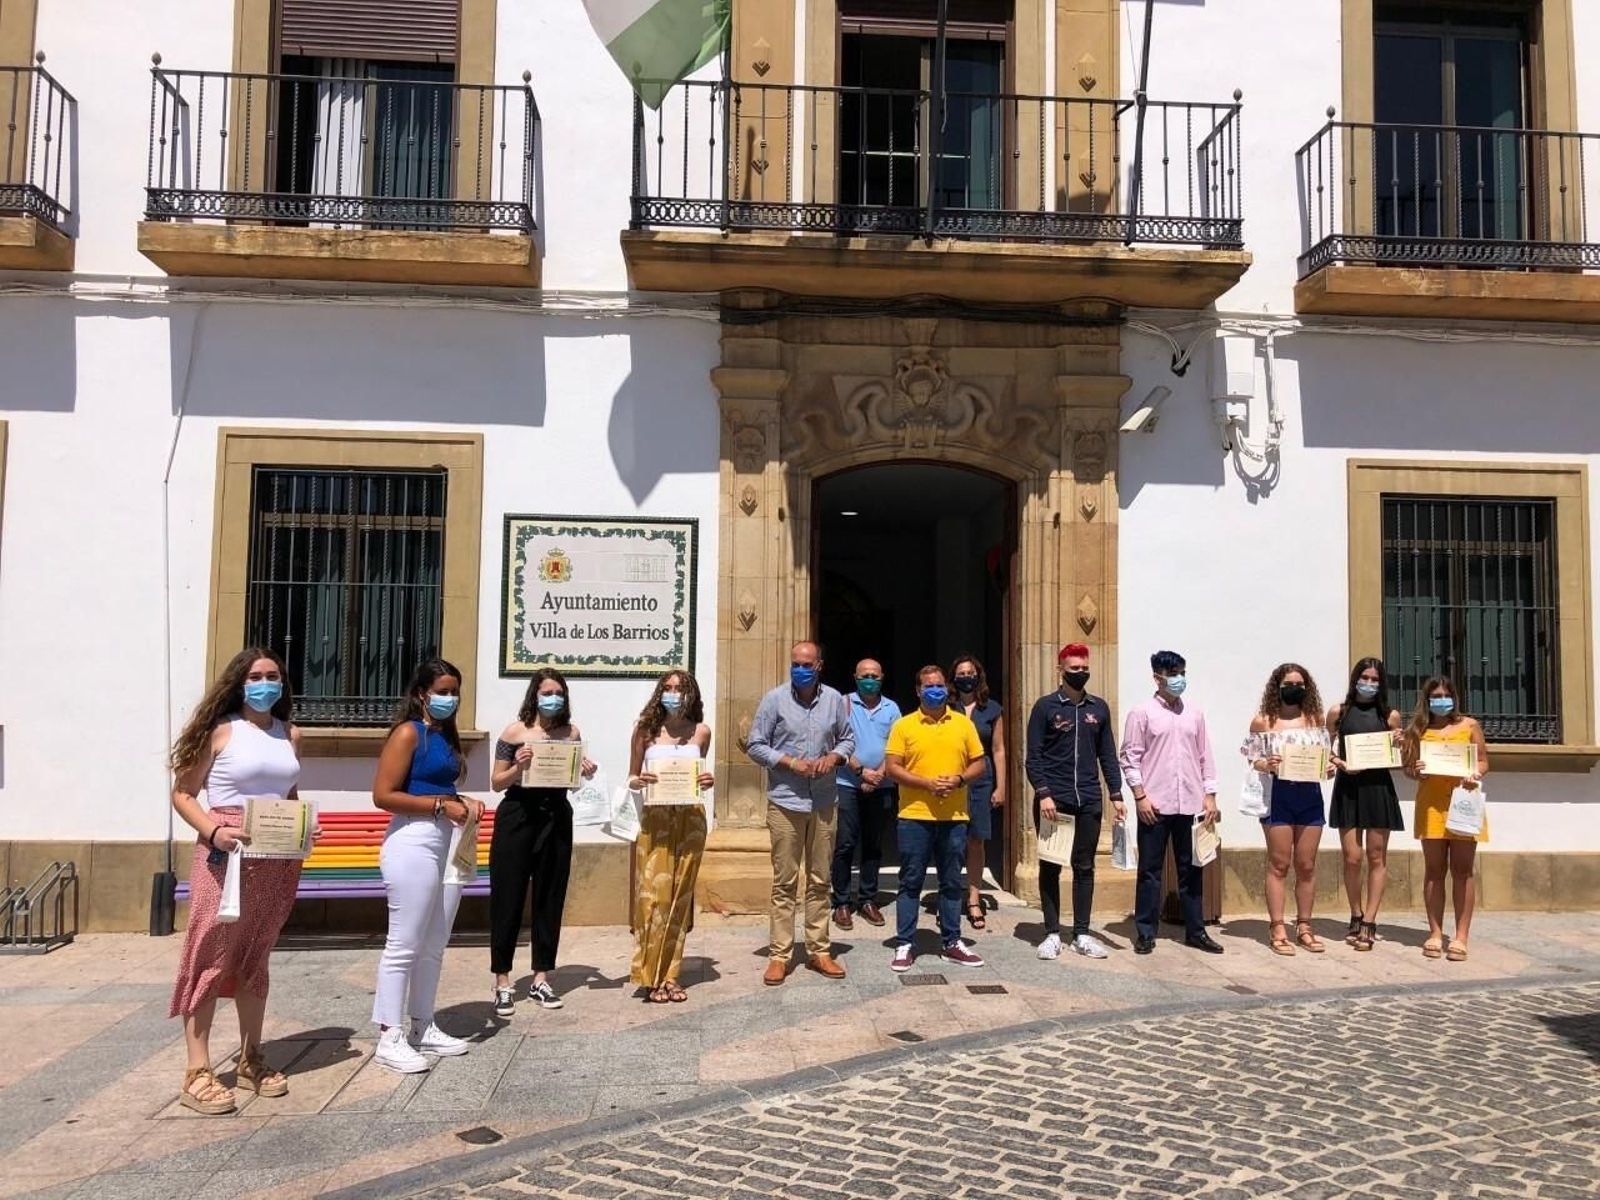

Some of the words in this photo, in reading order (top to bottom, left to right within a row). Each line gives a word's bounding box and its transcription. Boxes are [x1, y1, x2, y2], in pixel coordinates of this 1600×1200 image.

[540, 591, 658, 614] Ayuntamiento
[529, 622, 567, 639] Villa
[570, 623, 584, 639] de
[587, 623, 609, 640] Los
[612, 623, 670, 640] Barrios
